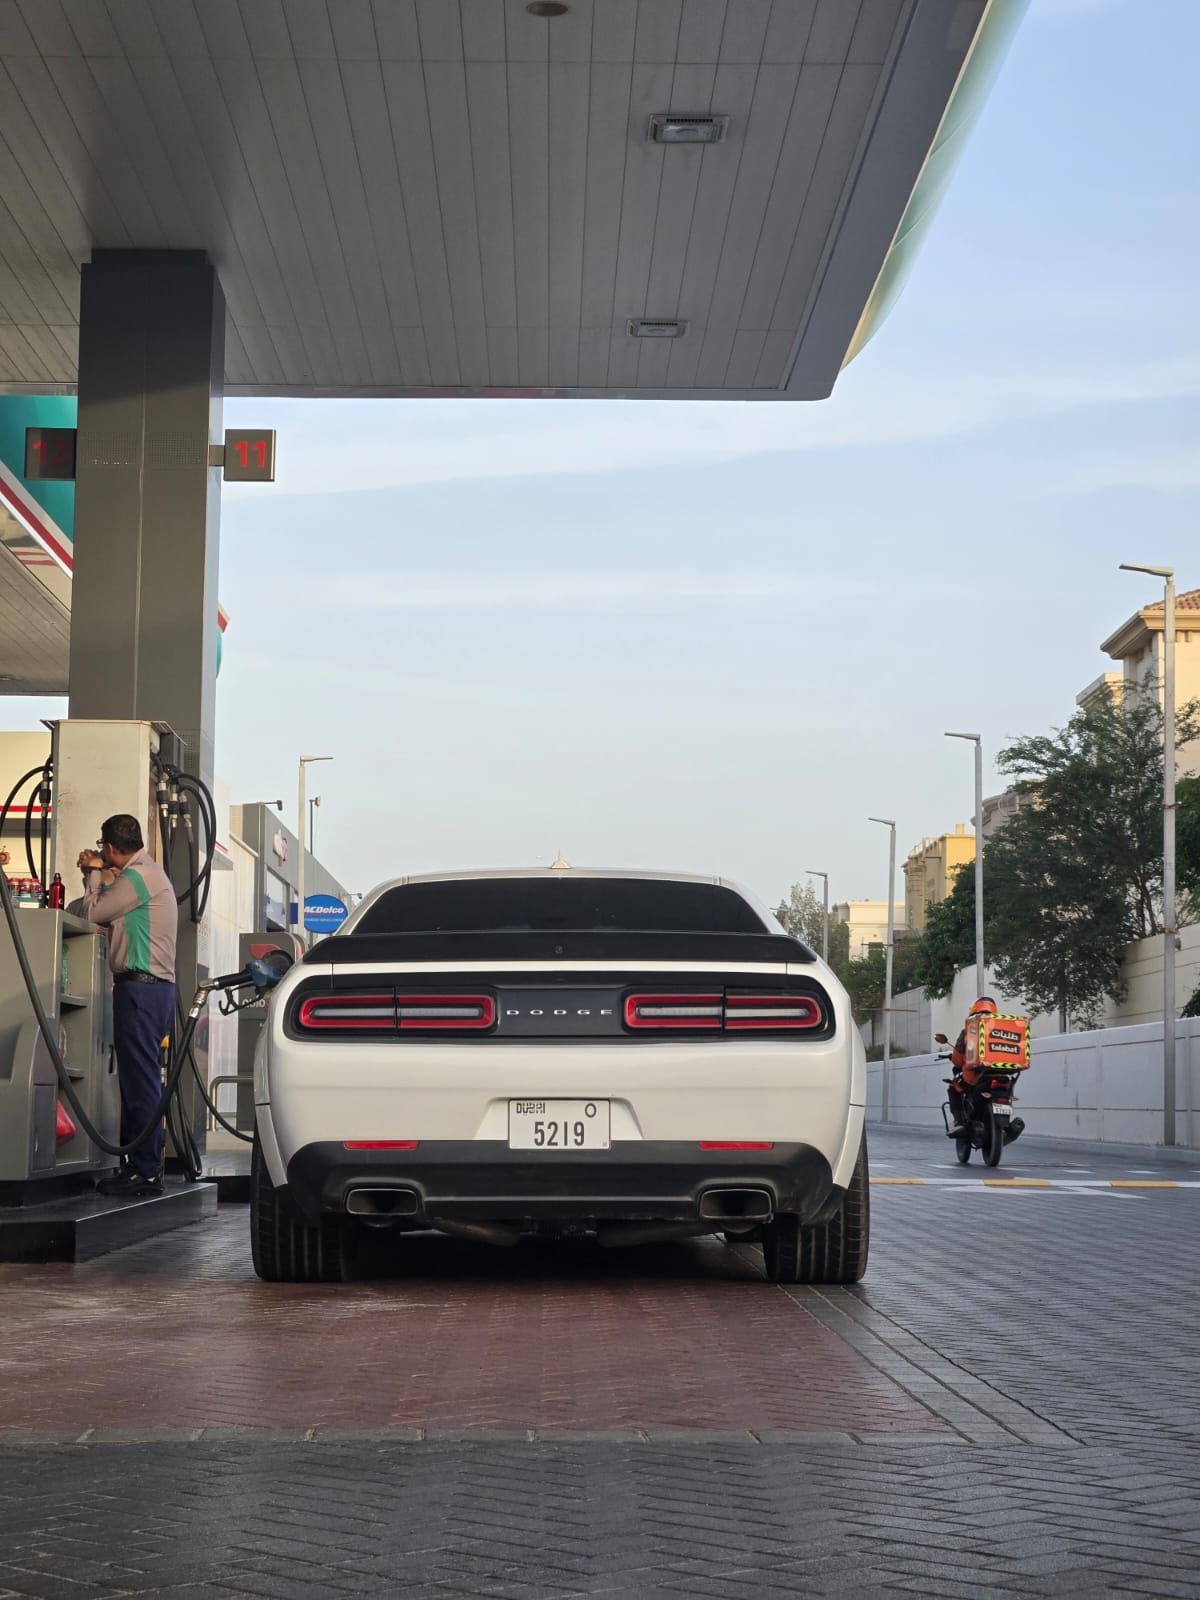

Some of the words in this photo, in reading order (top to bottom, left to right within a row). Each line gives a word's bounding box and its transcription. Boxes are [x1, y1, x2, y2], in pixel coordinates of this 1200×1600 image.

[234, 440, 266, 468] 11
[990, 1043, 1019, 1054] talabat
[534, 1121, 585, 1147] 5219
